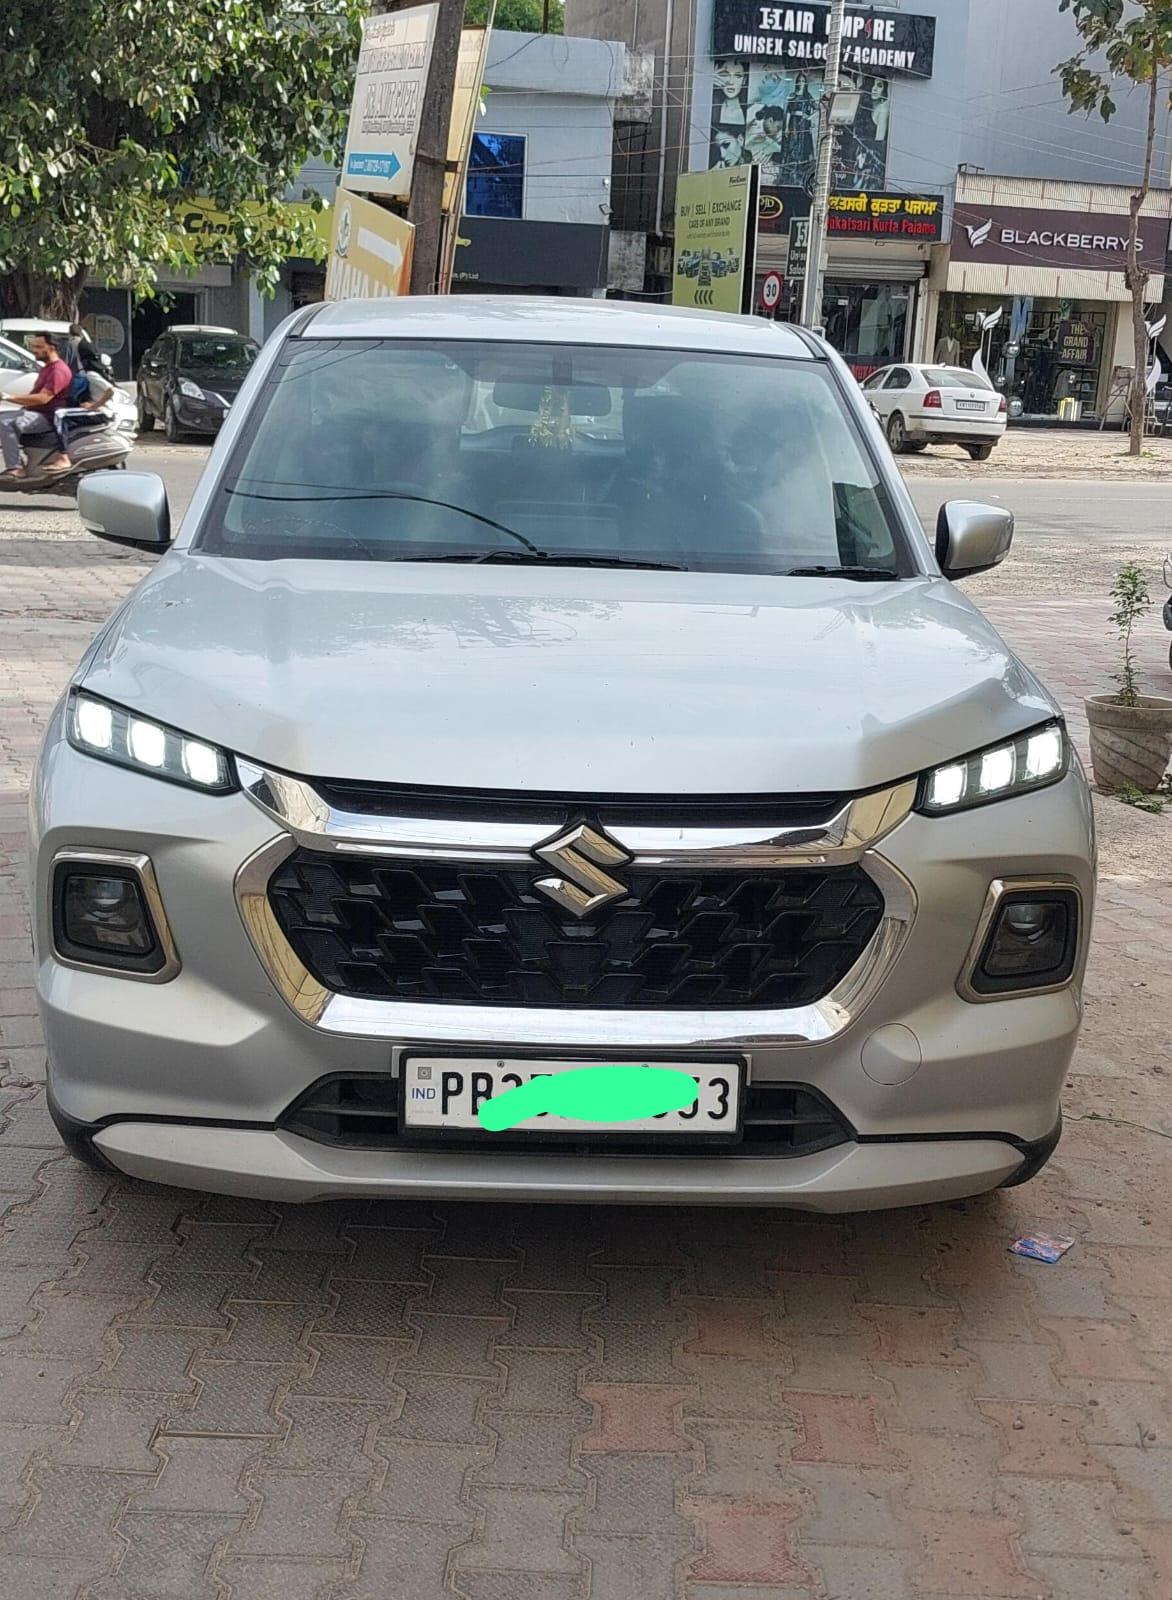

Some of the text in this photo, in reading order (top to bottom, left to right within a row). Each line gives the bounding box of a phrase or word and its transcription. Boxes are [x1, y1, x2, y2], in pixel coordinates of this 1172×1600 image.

[758, 7, 815, 35] HAIR
[733, 34, 783, 56] UNISEX
[788, 40, 831, 60] SALOO
[853, 46, 915, 69] ACADEMY
[681, 199, 742, 217] BUY SELL EXCHANGE
[827, 215, 937, 236] ukatsari Kurta Pajama
[765, 285, 777, 298] 30
[1071, 323, 1086, 336] THE
[1063, 336, 1088, 348] GRAND
[1060, 348, 1088, 360] AFFAIR
[411, 1087, 436, 1099] IND
